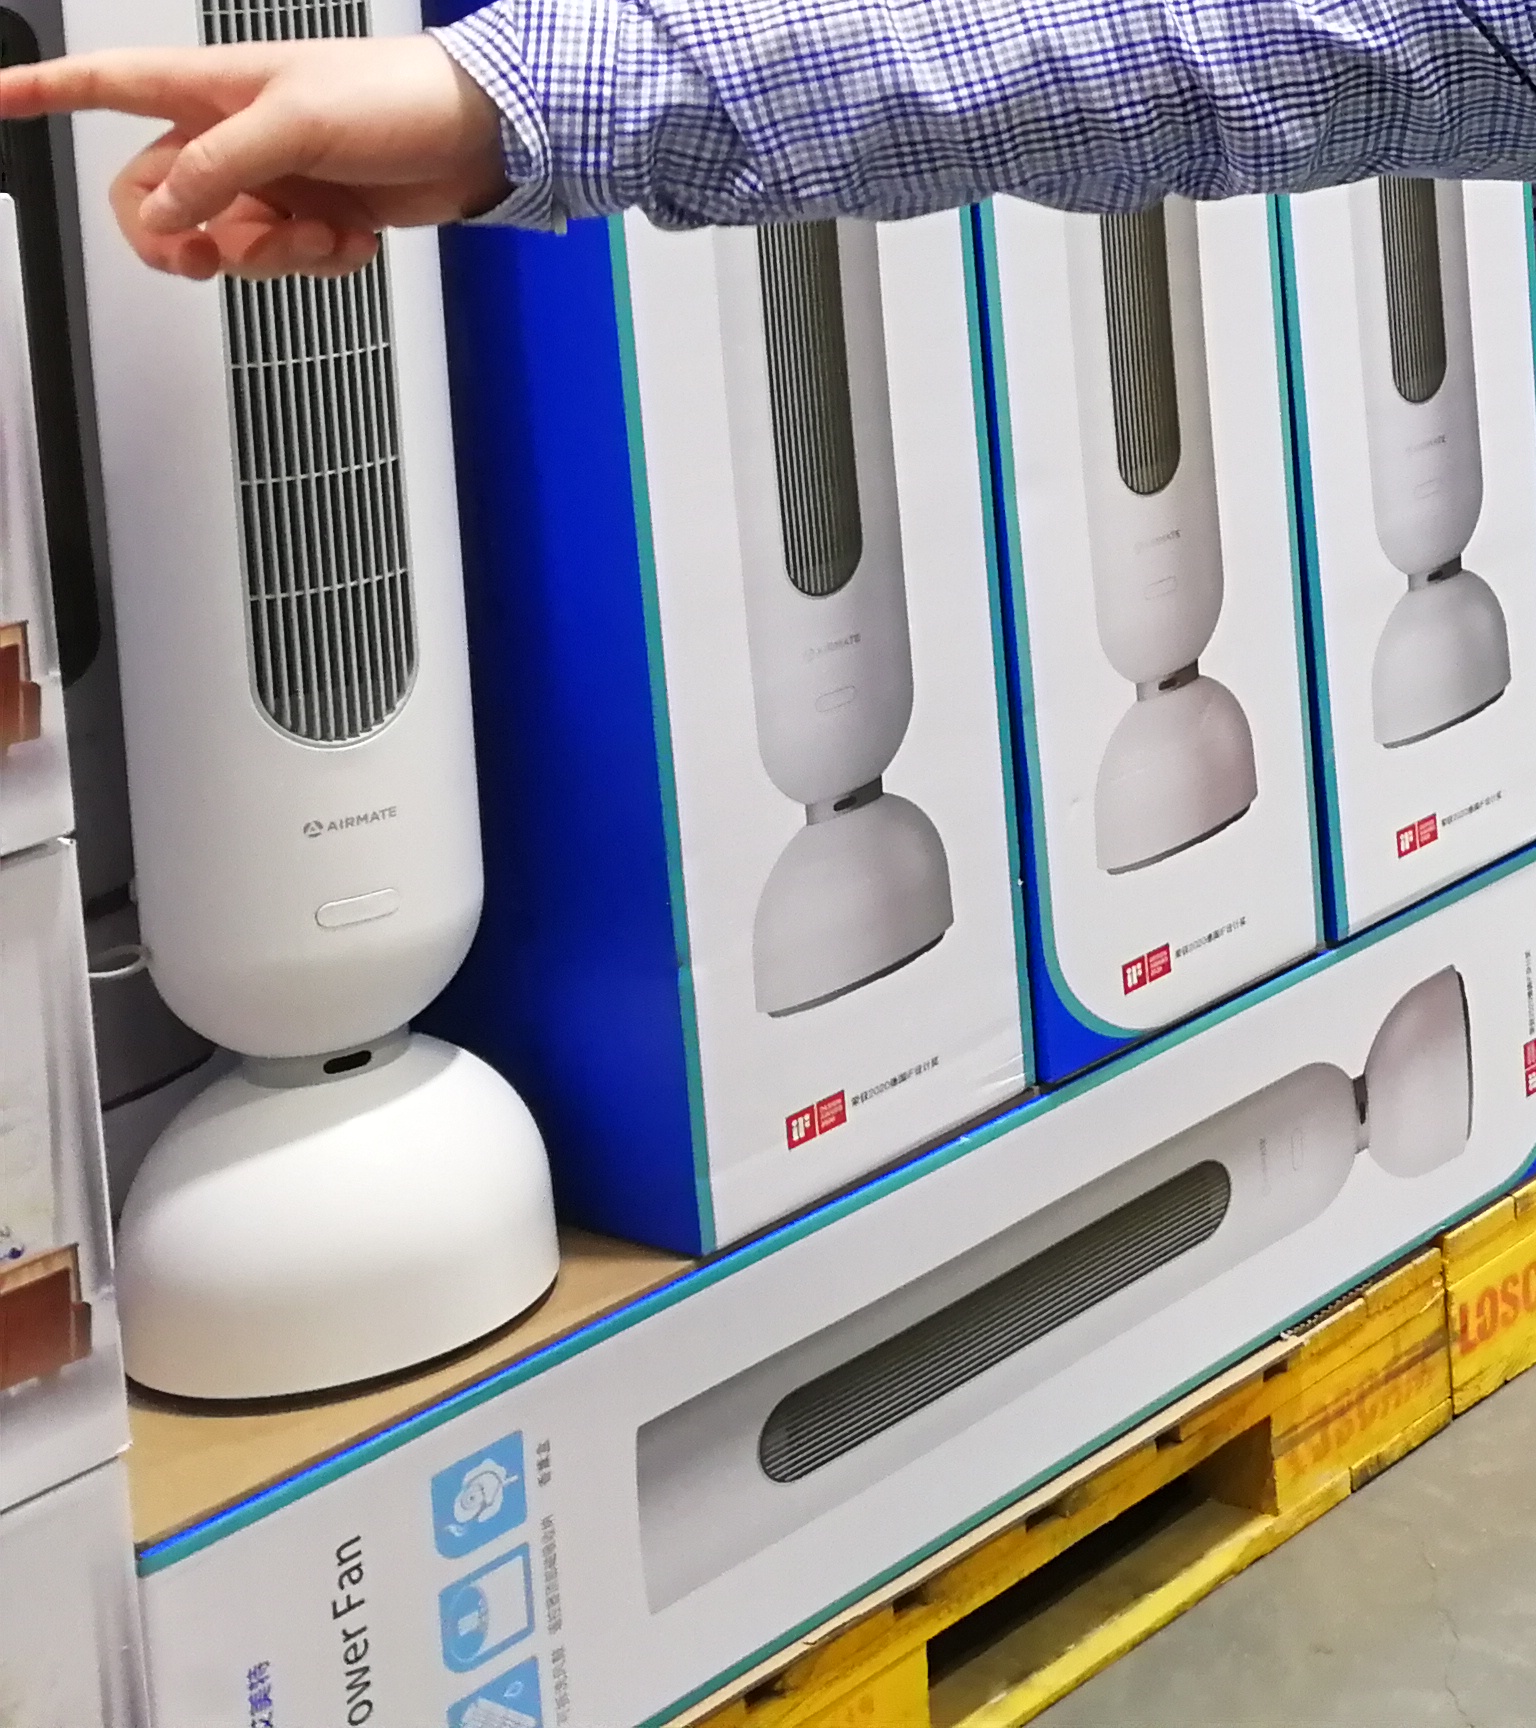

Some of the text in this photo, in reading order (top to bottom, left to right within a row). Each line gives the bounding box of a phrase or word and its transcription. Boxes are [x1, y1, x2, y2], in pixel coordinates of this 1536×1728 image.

[327, 804, 398, 834] AIRMATE
[332, 1534, 374, 1728] ower Fan
